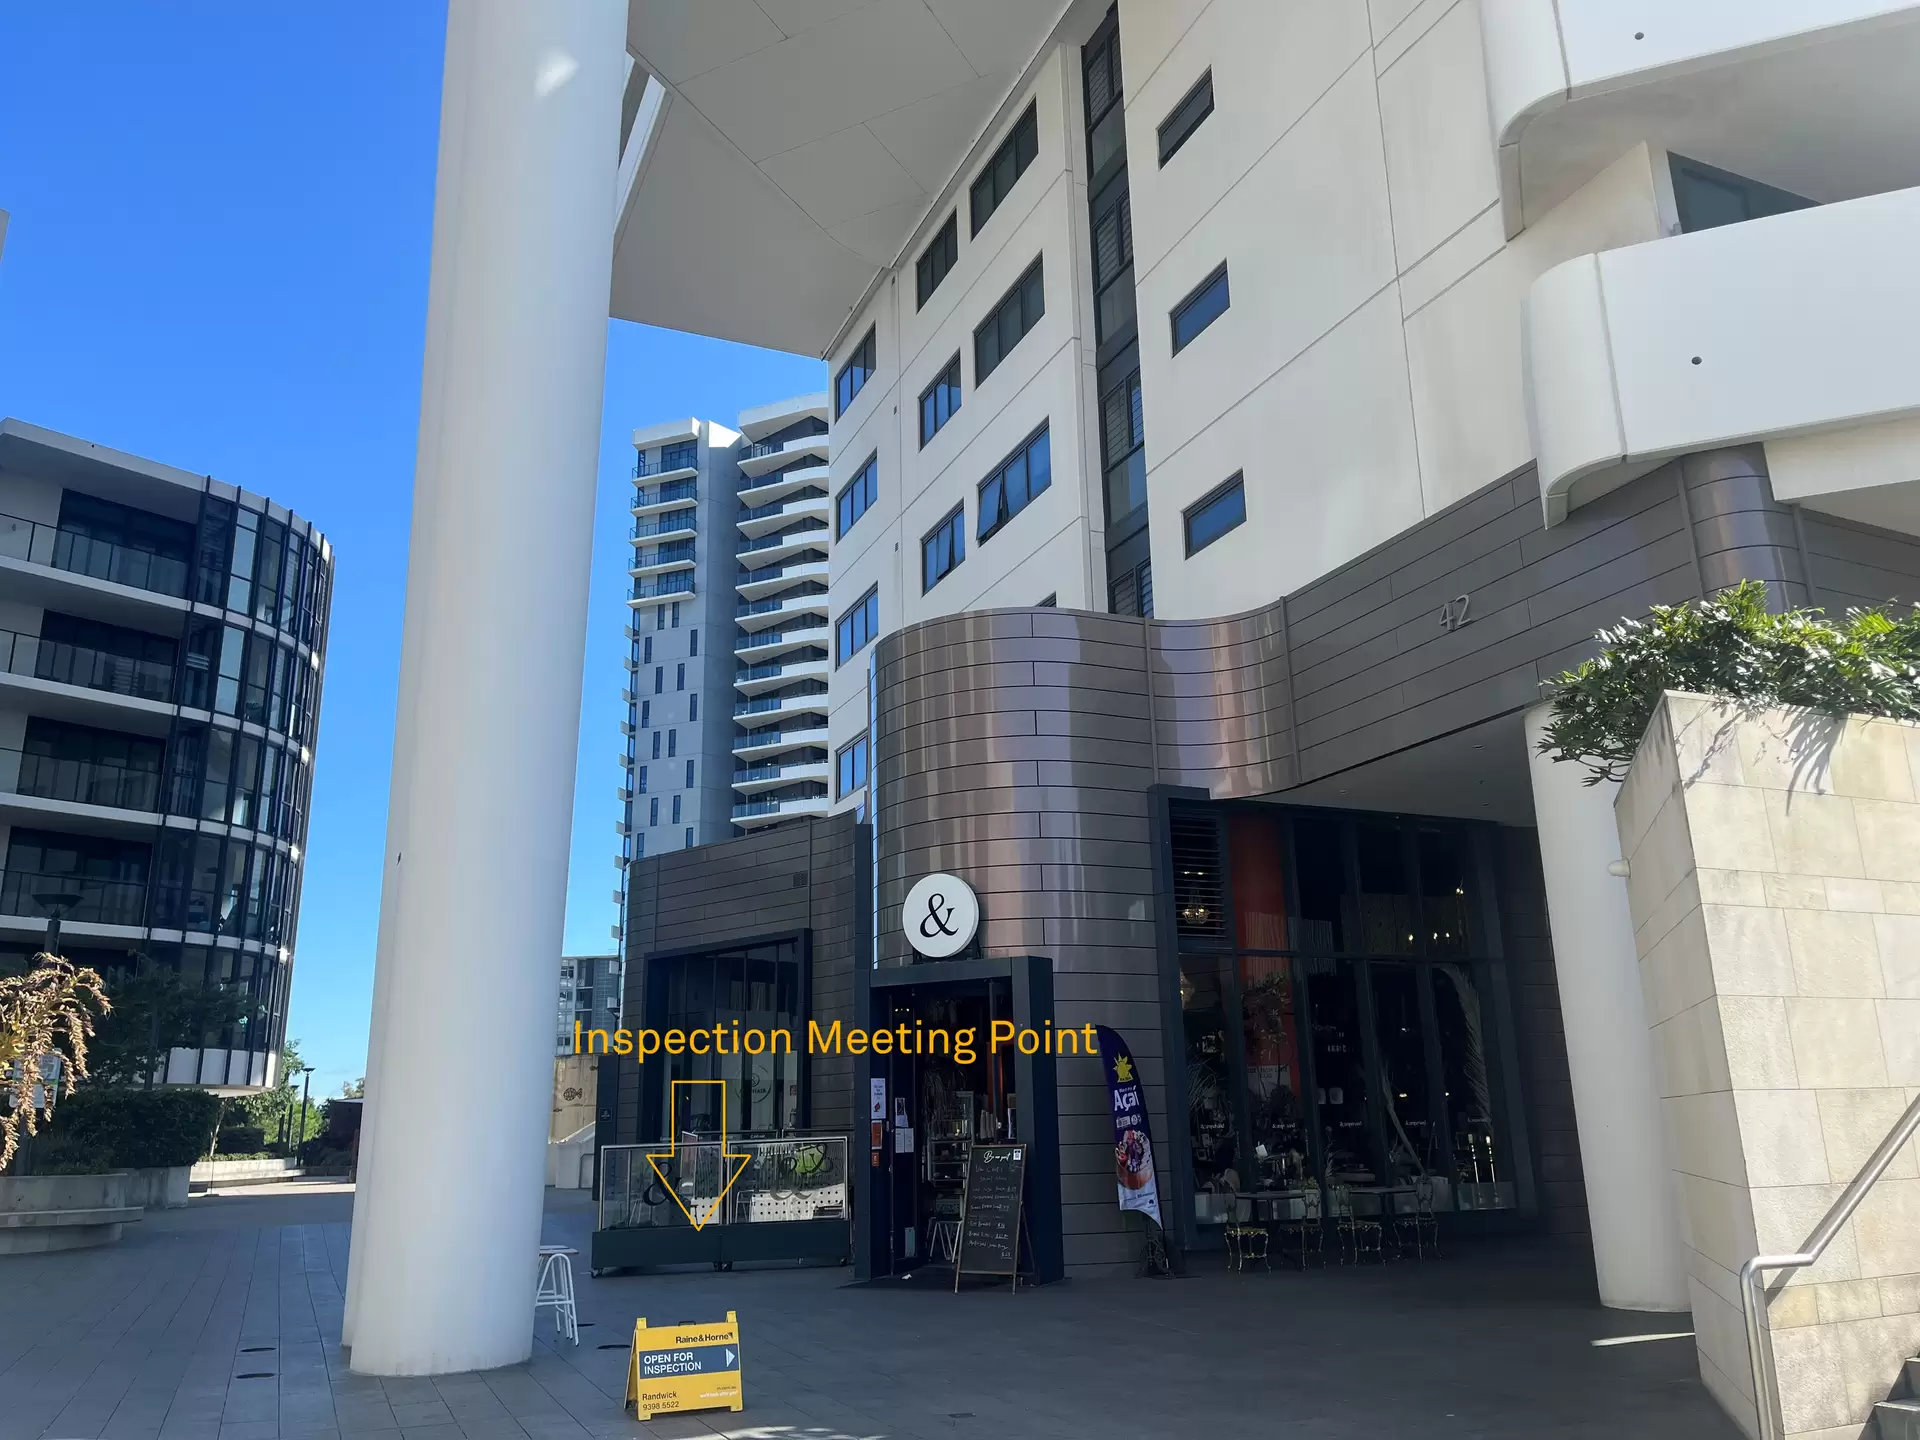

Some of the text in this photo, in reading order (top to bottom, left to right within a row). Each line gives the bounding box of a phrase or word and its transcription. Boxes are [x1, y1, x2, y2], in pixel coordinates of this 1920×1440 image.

[1439, 594, 1471, 631] 42
[920, 893, 959, 938] &
[1114, 1084, 1140, 1112] Açaí
[643, 1351, 694, 1365] OPEN FOR
[644, 1361, 702, 1375] INSPECTION
[642, 1391, 677, 1401] Randwick
[642, 1400, 680, 1411] 9398 5522
